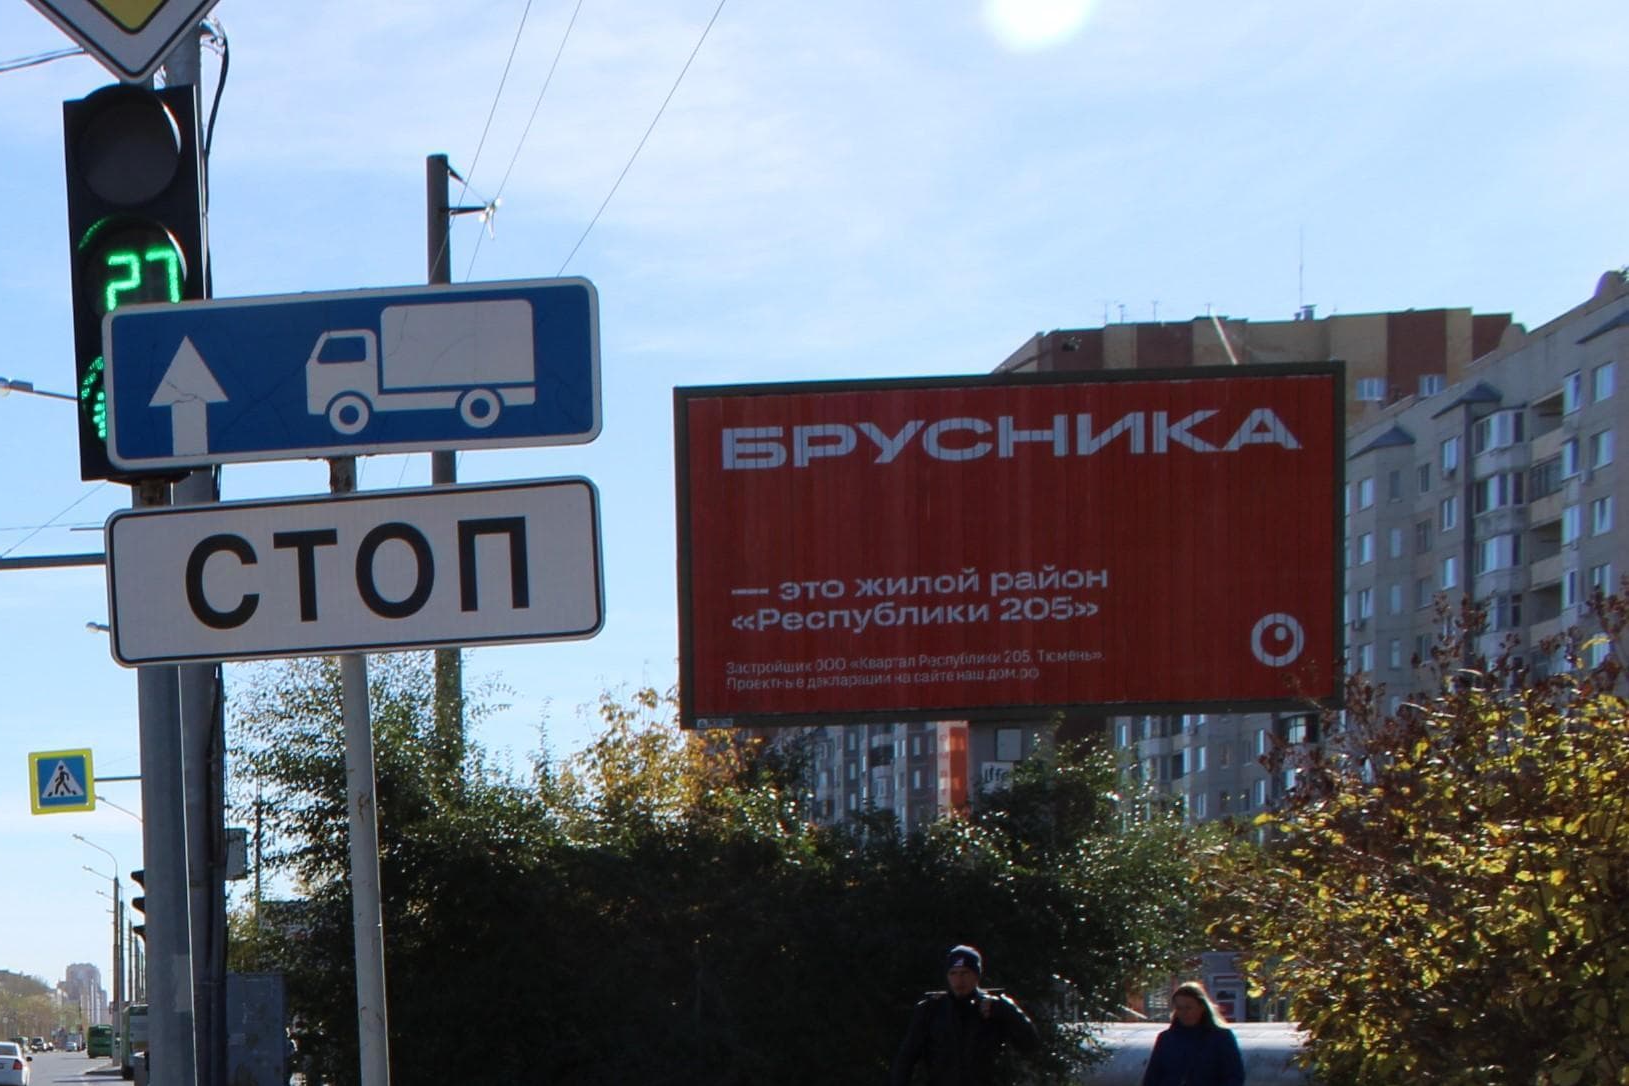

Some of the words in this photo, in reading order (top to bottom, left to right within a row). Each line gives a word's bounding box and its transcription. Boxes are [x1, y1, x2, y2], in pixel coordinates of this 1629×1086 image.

[107, 250, 180, 311] 27
[722, 408, 1303, 470] БРУСНИКА
[185, 516, 529, 629] СТОП
[779, 579, 845, 600] это
[854, 567, 980, 597] жилой
[990, 564, 1108, 597] район
[732, 601, 990, 634] «Республики
[999, 596, 1099, 621] 205»
